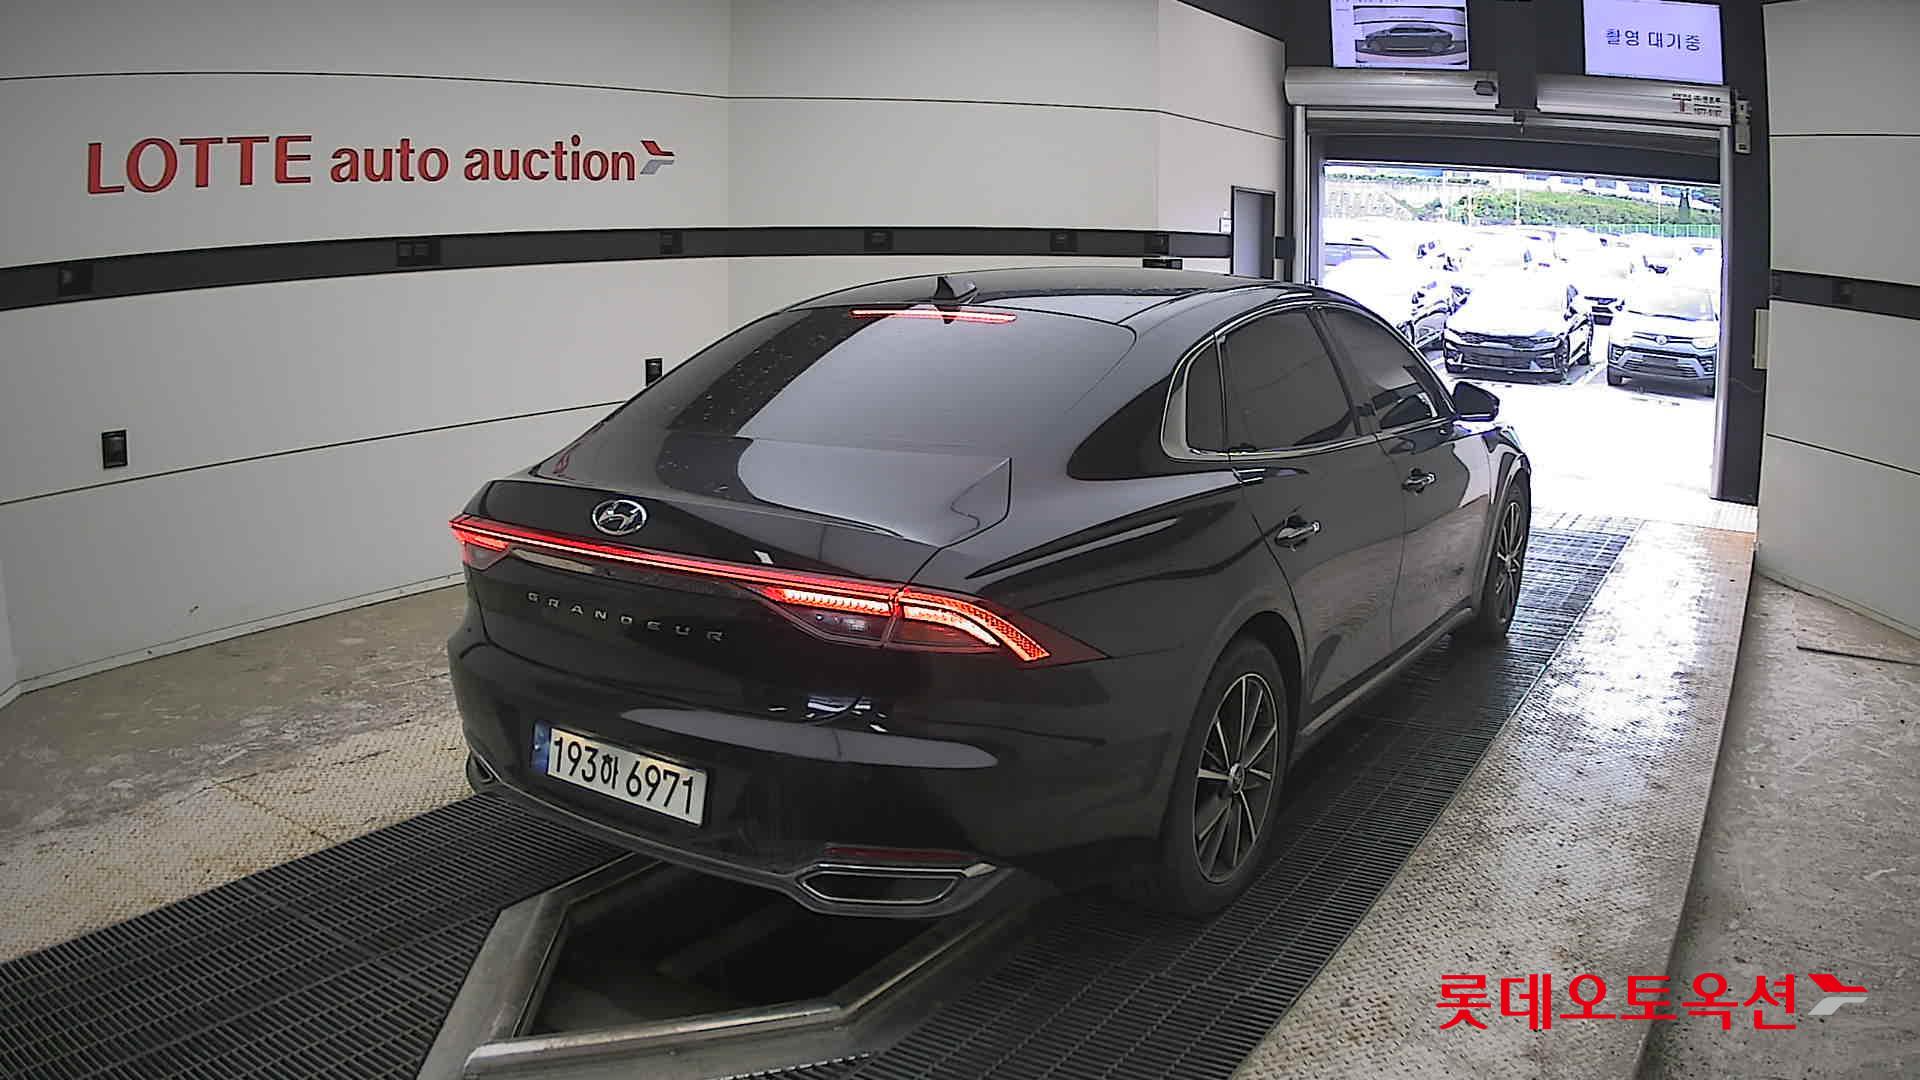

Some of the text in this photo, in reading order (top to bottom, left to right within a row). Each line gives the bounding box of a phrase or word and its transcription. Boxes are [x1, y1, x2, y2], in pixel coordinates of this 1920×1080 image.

[1648, 31, 1701, 52] 대기중
[87, 134, 636, 194] LOTTE auto auction
[527, 591, 724, 642] GRANDEUR
[554, 736, 694, 815] 193하 6971
